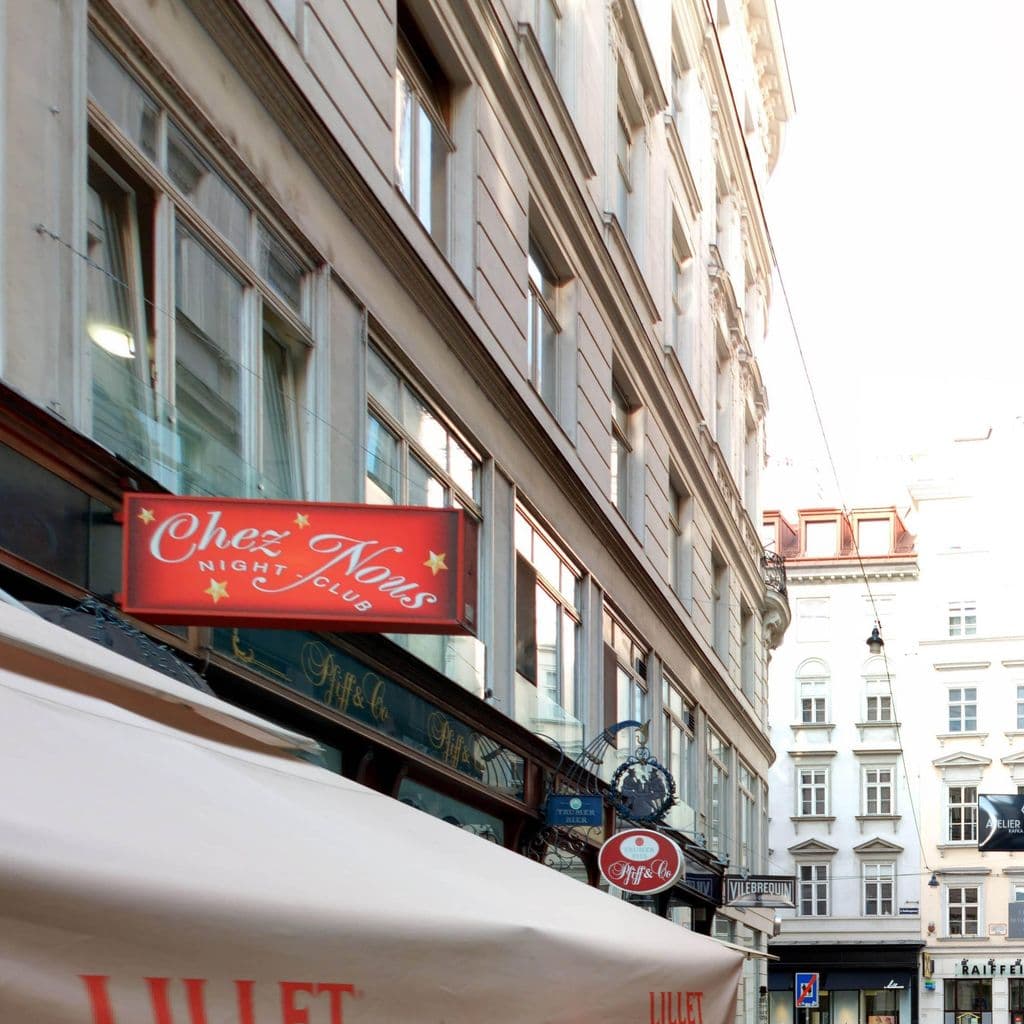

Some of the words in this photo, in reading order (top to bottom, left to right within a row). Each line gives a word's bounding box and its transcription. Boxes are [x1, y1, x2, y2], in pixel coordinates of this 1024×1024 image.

[150, 511, 290, 564] Chez
[252, 534, 437, 609] Nous
[198, 560, 287, 576] NIGHT
[313, 576, 373, 612] CLUB
[985, 819, 1020, 829] AELIER
[730, 881, 792, 900] VILEBREQUIN
